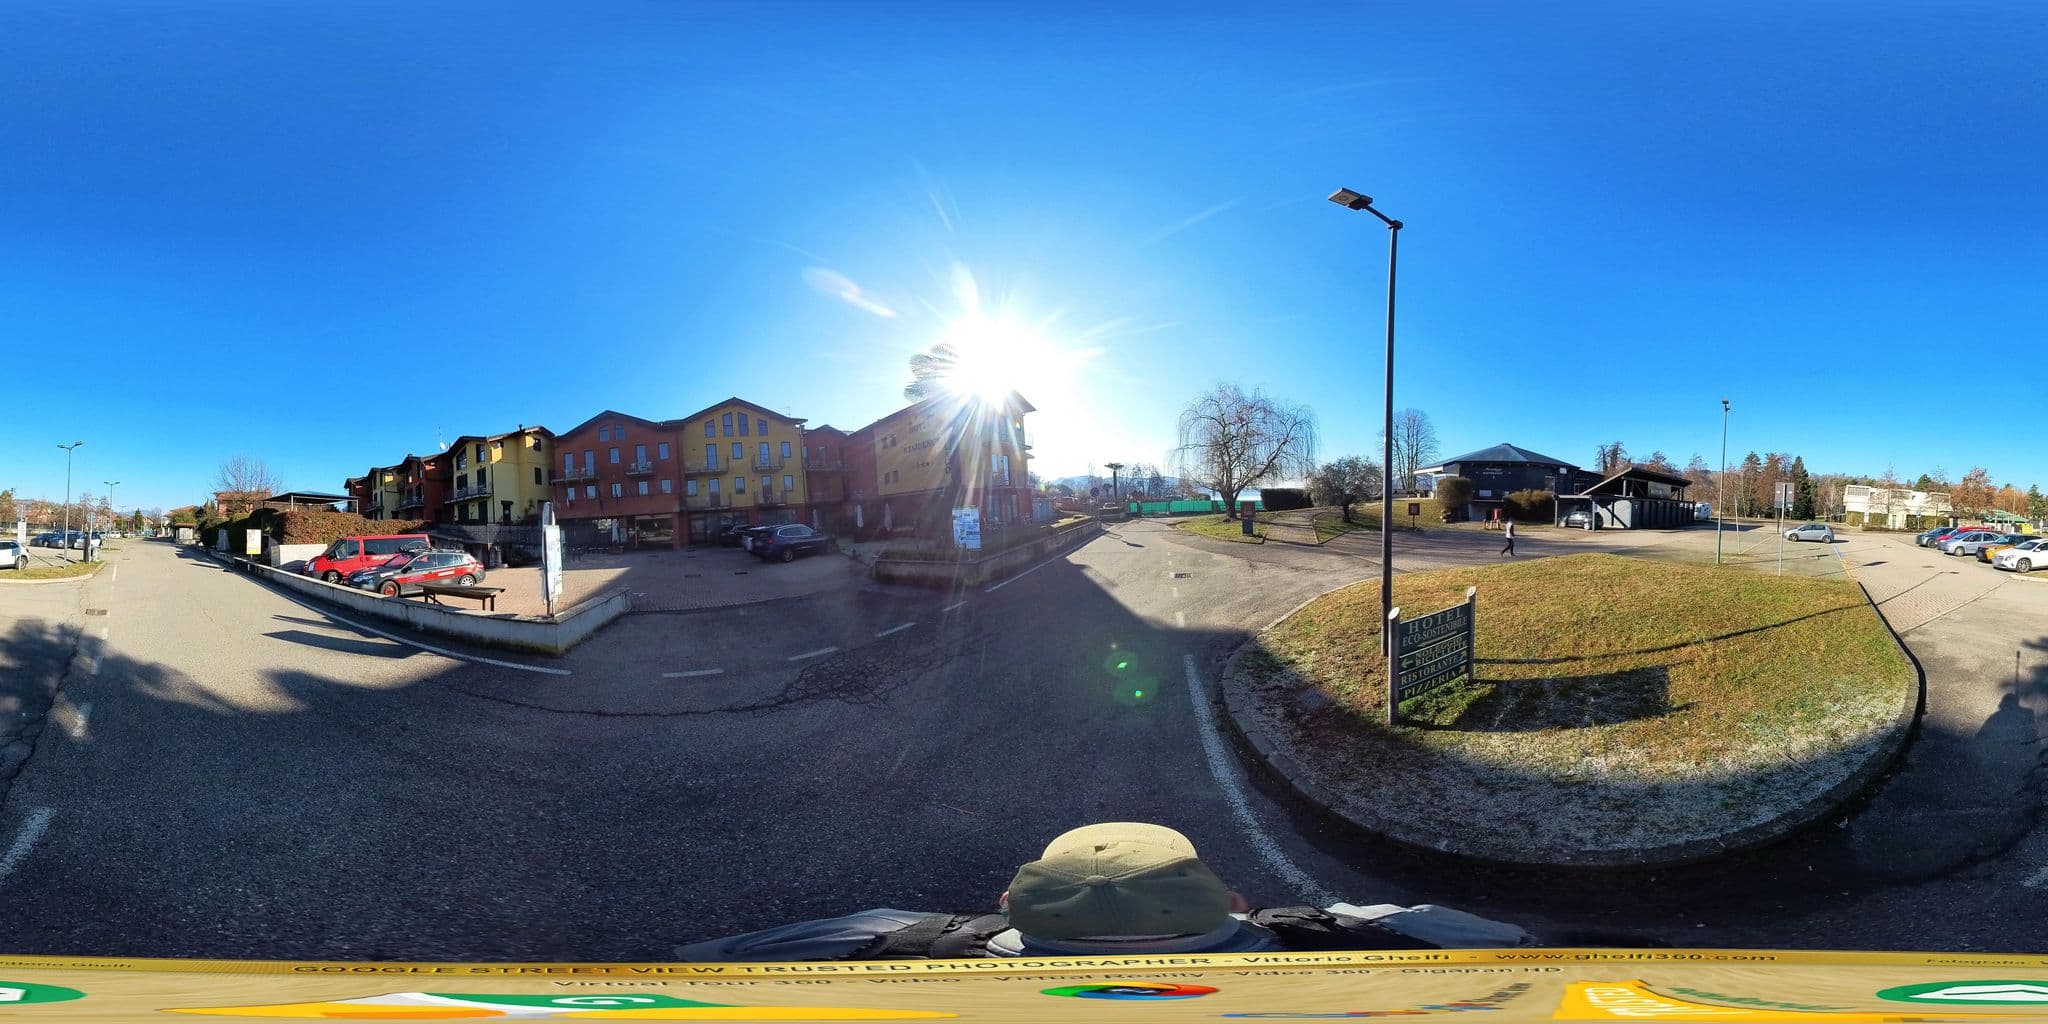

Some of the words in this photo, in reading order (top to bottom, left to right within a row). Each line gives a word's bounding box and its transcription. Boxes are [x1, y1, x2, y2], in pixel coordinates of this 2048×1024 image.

[1403, 616, 1468, 646] ECO-SOSTENIBILE
[1409, 607, 1463, 634] HOTEL
[1415, 636, 1463, 659] NOLEGGIO
[1401, 655, 1458, 685] RISTORANTE
[1404, 671, 1456, 698] PIZZERIA
